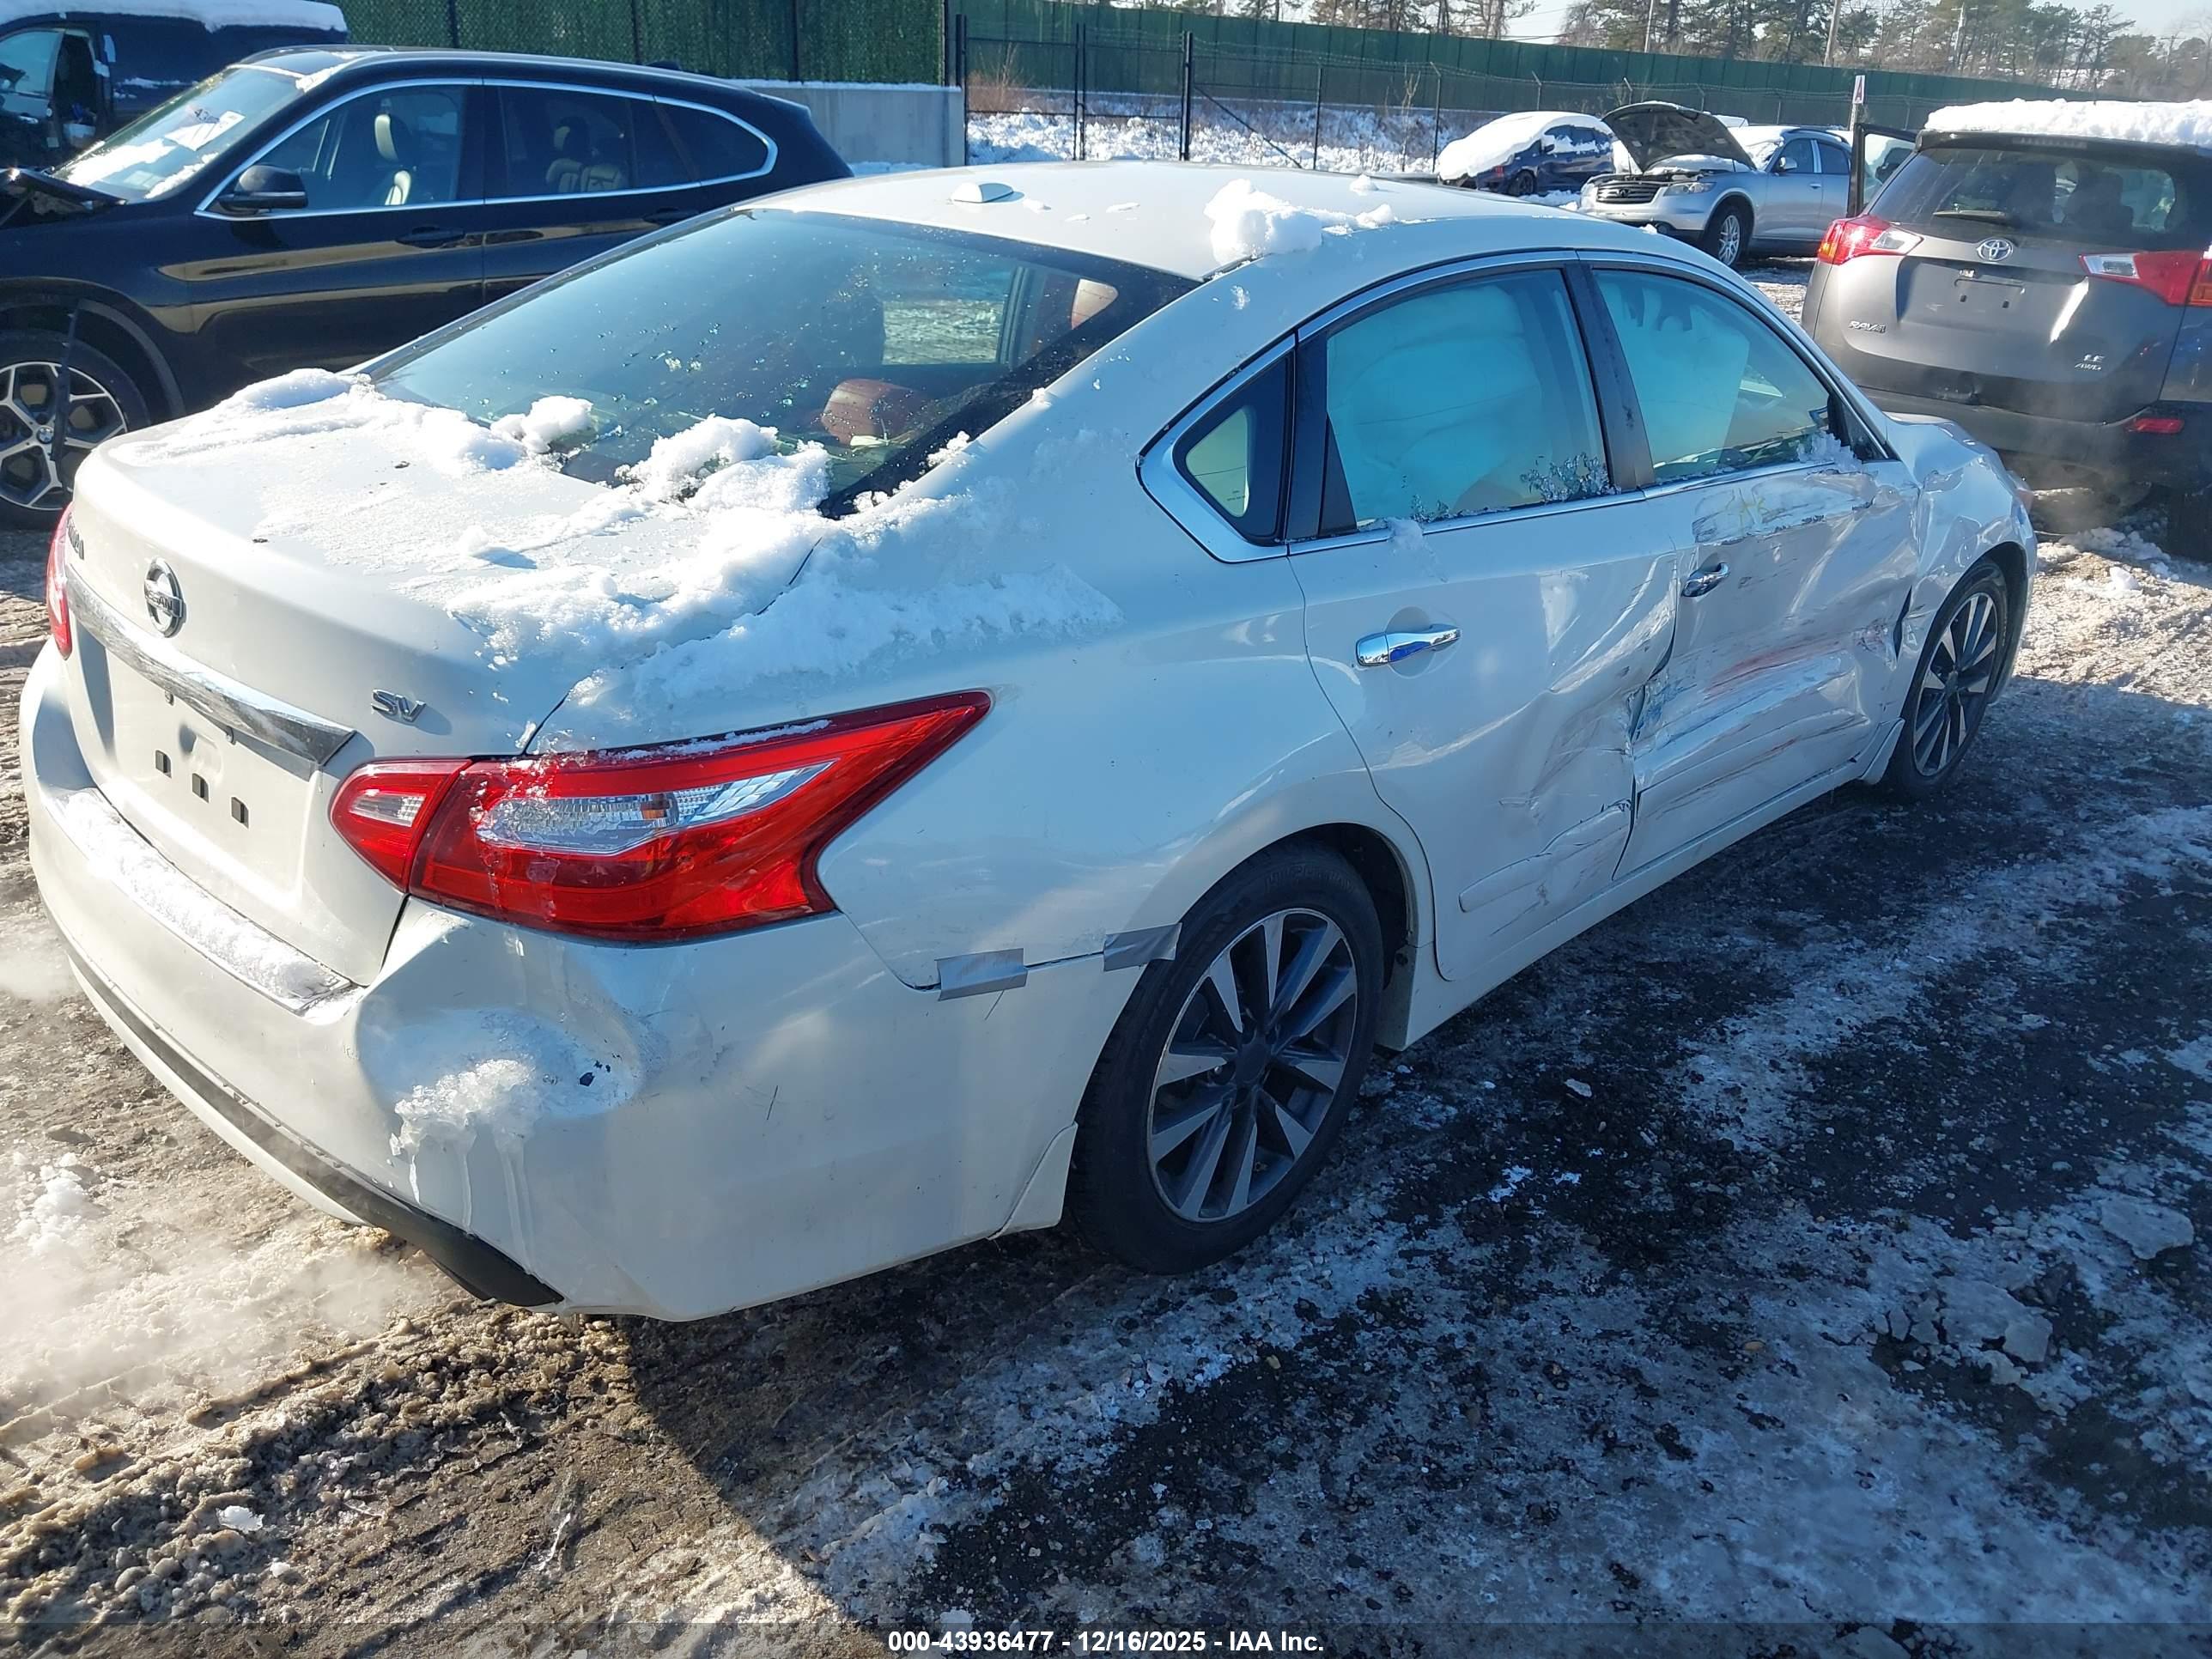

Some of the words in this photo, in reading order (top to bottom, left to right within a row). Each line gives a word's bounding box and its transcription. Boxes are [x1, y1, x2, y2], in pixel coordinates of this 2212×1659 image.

[1855, 76, 1863, 101] A
[1848, 320, 1887, 334] RAV4
[370, 689, 427, 723] SV
